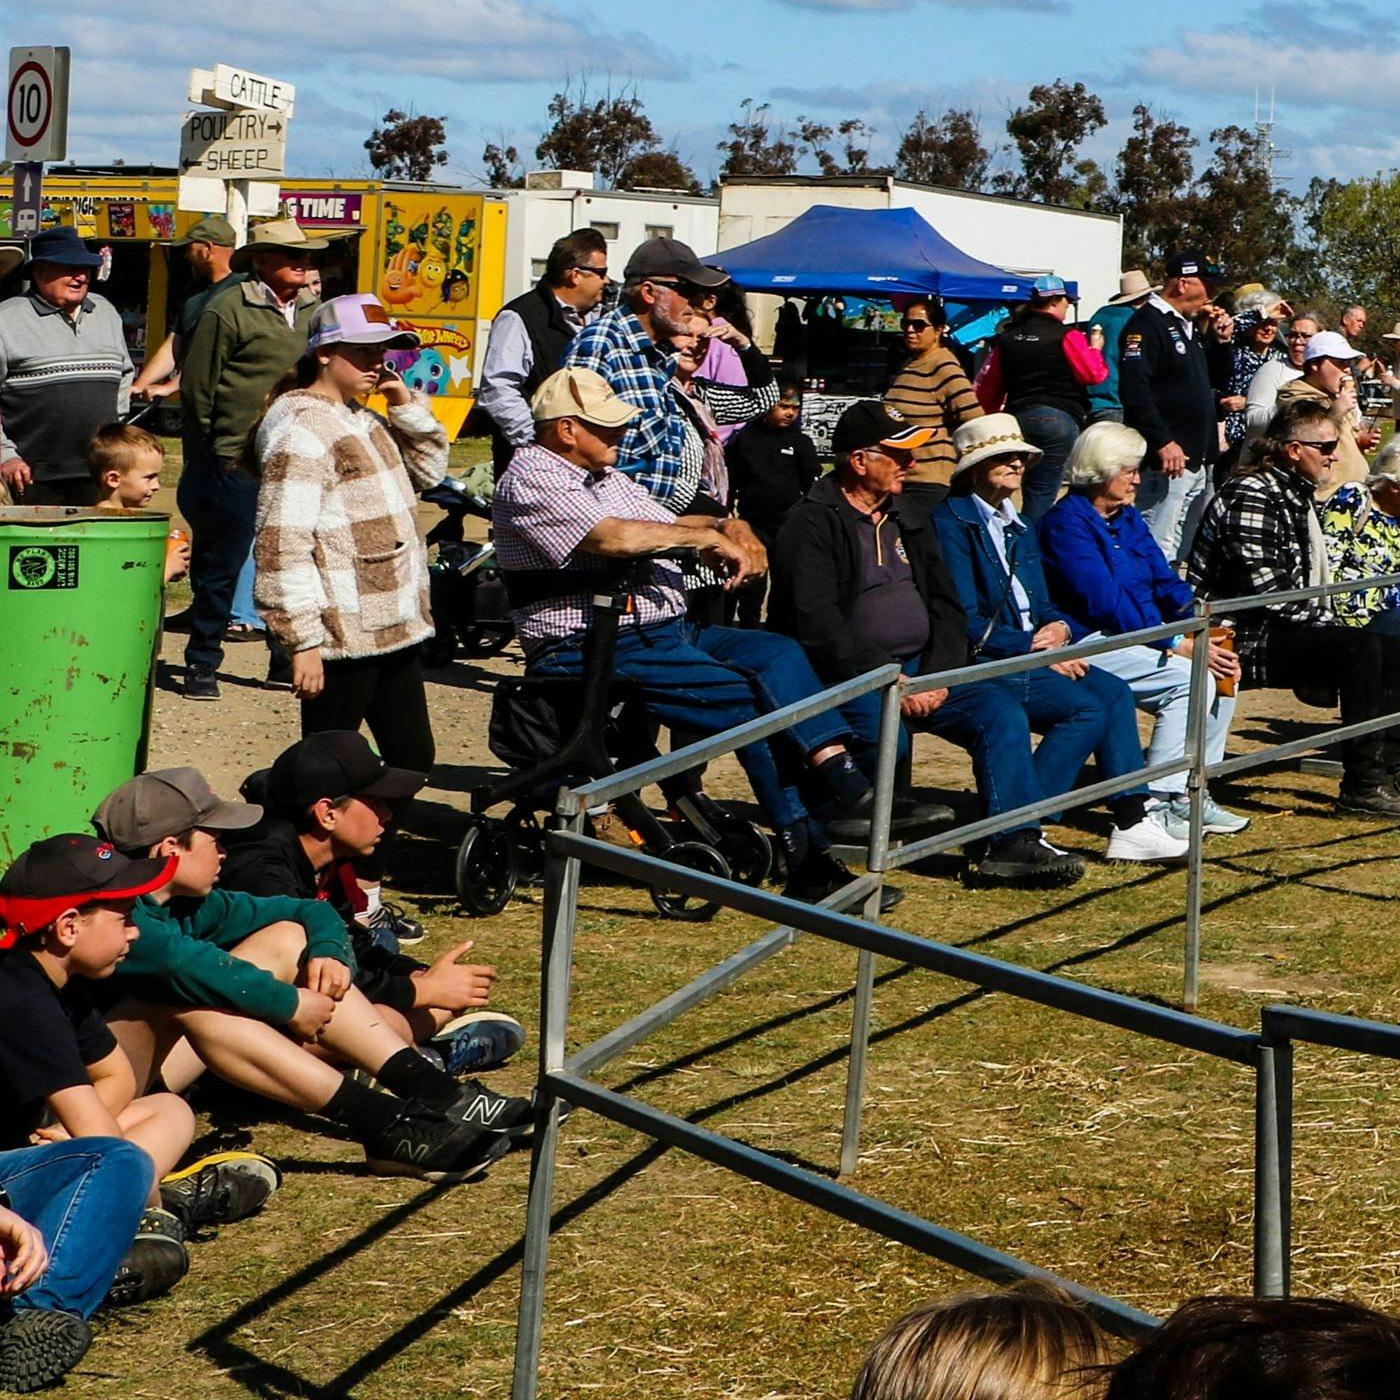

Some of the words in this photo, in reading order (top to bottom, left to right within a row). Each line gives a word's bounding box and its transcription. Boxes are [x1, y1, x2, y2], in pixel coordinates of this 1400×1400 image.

[19, 84, 41, 123] 10
[231, 74, 281, 109] CATTLE
[191, 114, 268, 141] POULTRY
[207, 149, 268, 171] SHEEP
[301, 197, 346, 219] TIME
